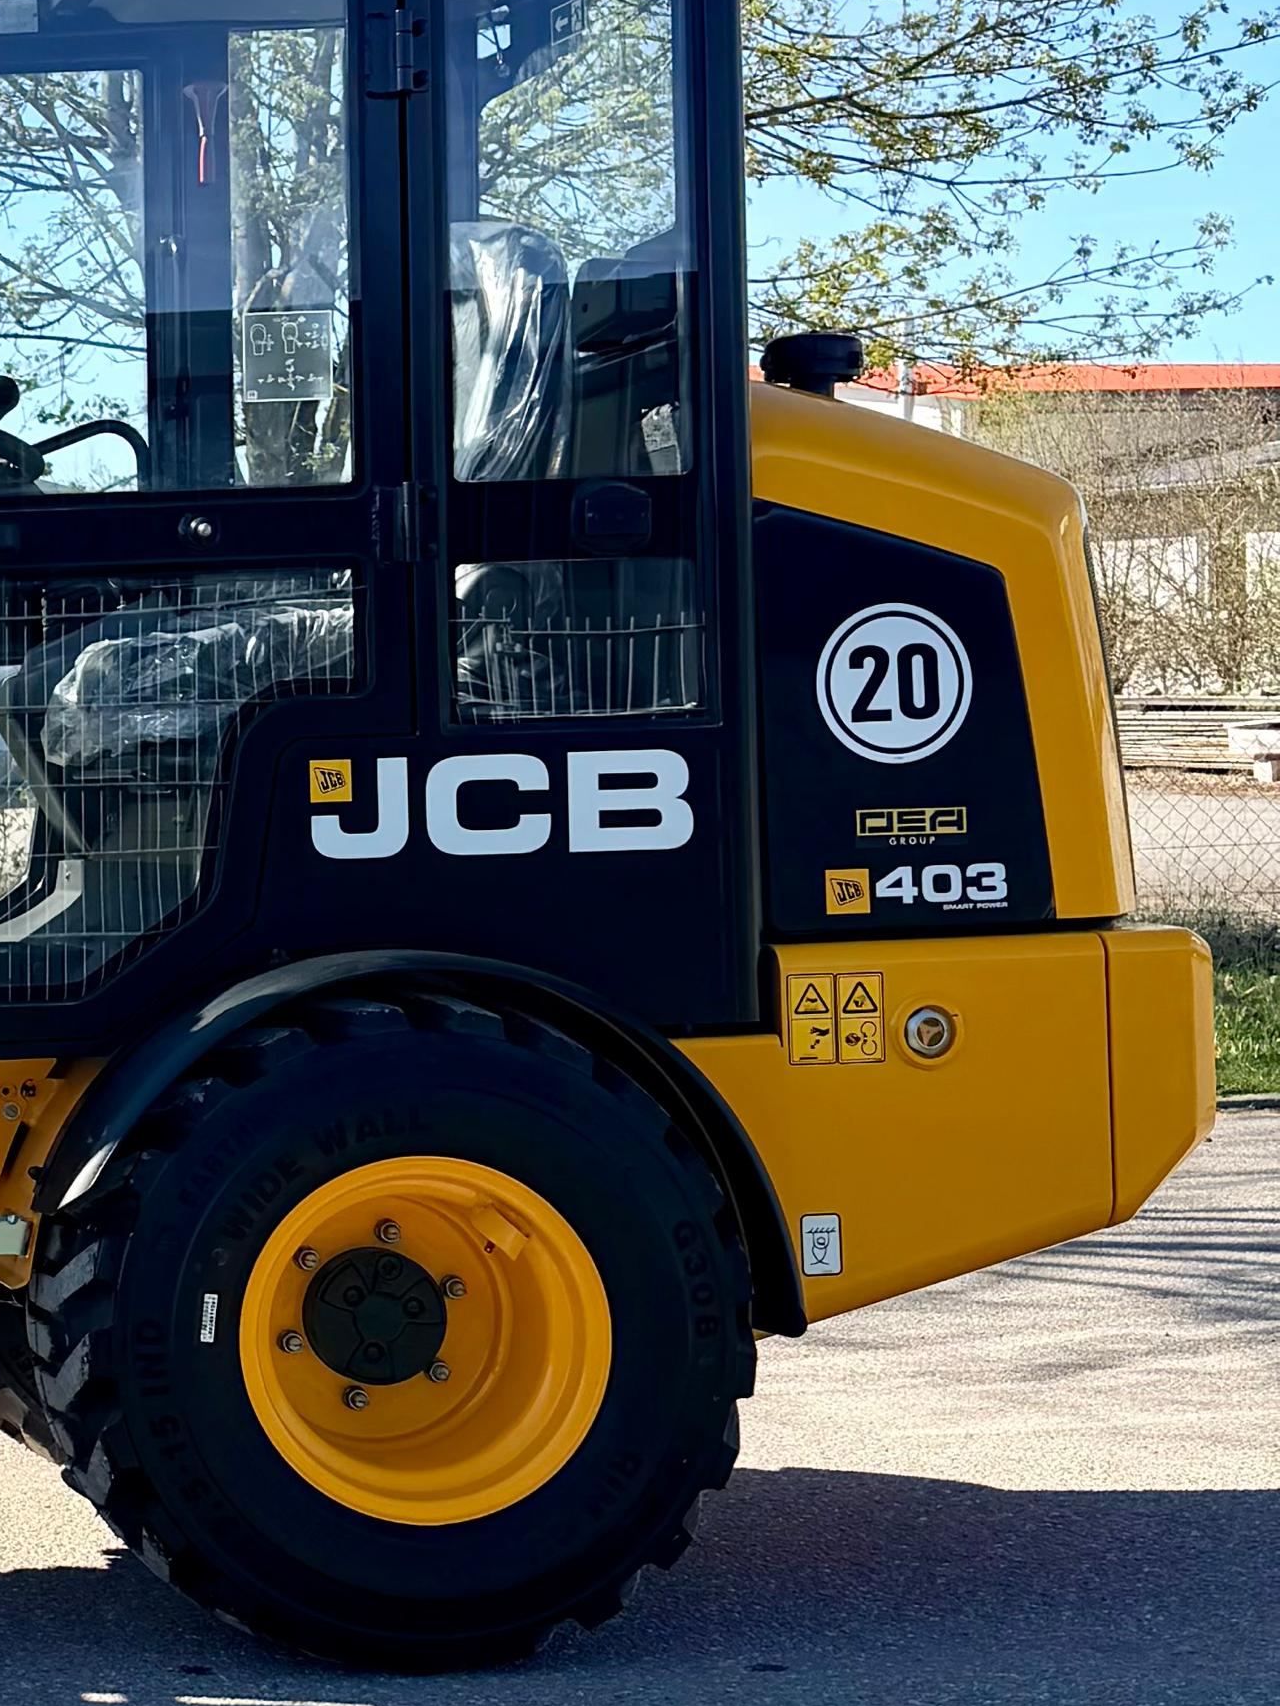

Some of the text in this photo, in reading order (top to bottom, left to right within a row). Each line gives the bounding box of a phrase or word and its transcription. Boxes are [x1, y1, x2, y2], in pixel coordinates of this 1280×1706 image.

[849, 642, 940, 722] 20
[319, 770, 344, 791] JCB
[310, 749, 693, 859] JCB
[888, 836, 936, 846] GROUP
[836, 862, 1008, 904] JCB 403
[943, 901, 1008, 911] SMART POWER
[215, 1101, 433, 1241] WIDE WALL
